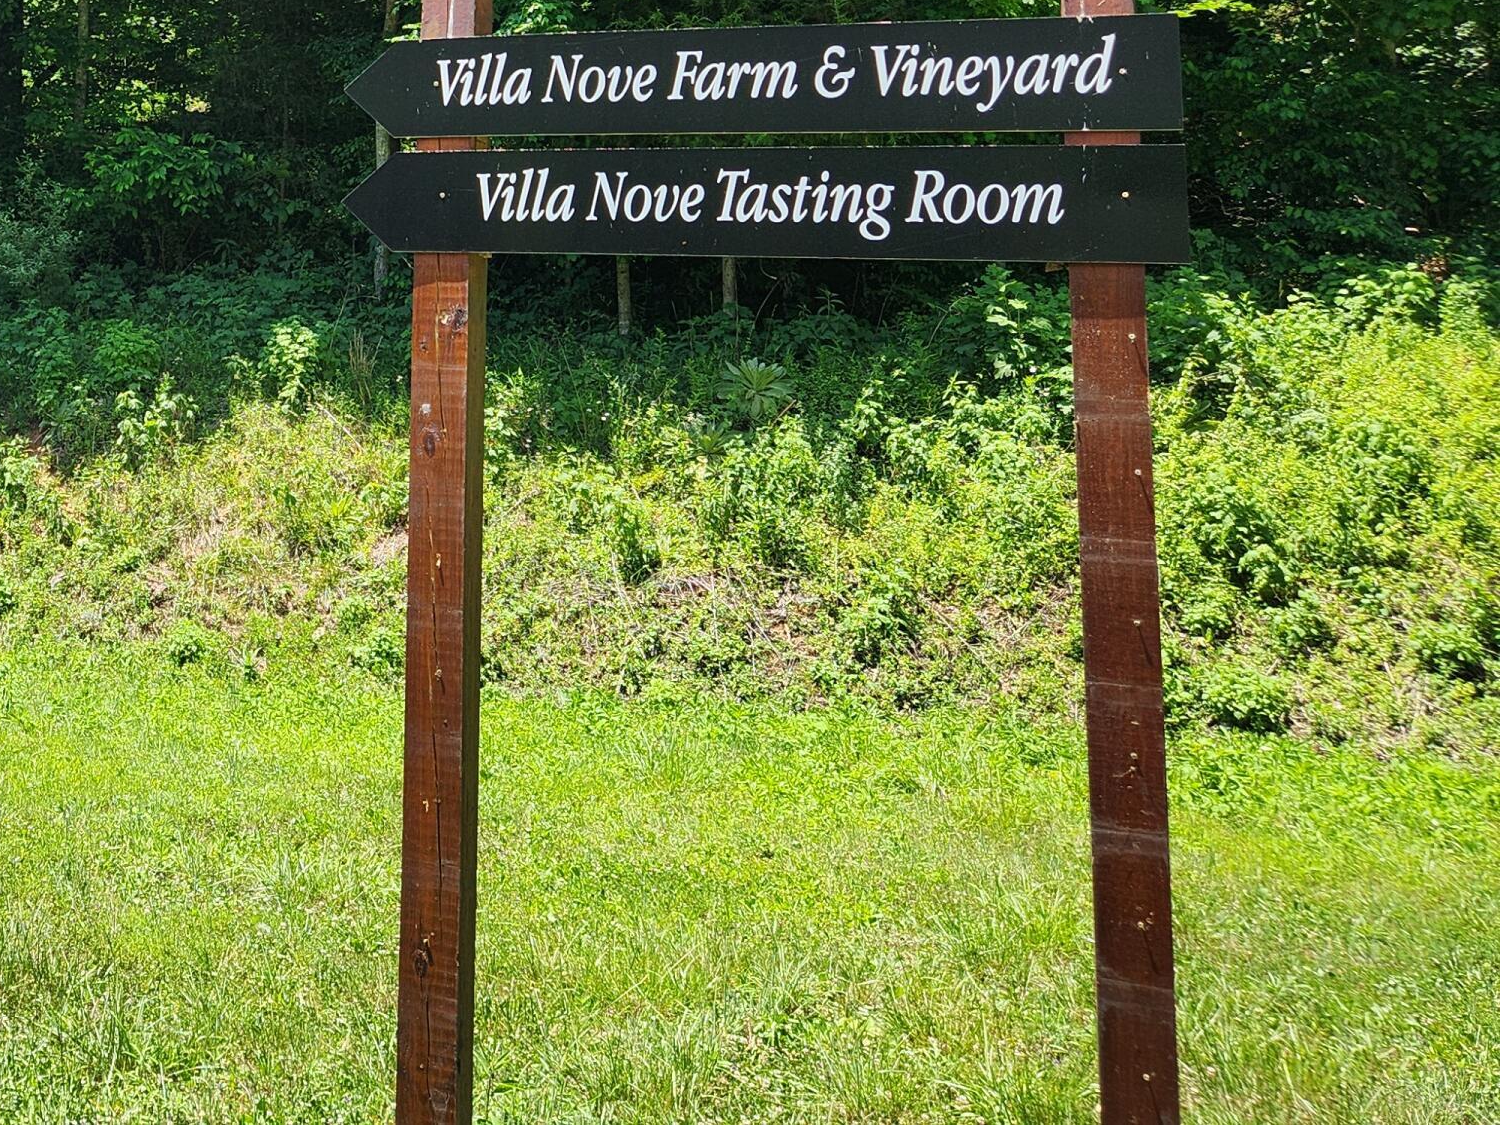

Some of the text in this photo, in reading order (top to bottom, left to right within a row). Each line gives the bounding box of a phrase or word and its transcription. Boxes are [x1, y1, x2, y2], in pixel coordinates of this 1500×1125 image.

[436, 33, 1116, 113] Villa Nove Farm & Vineyard
[476, 167, 1065, 241] Villa Nove Tasting Room
